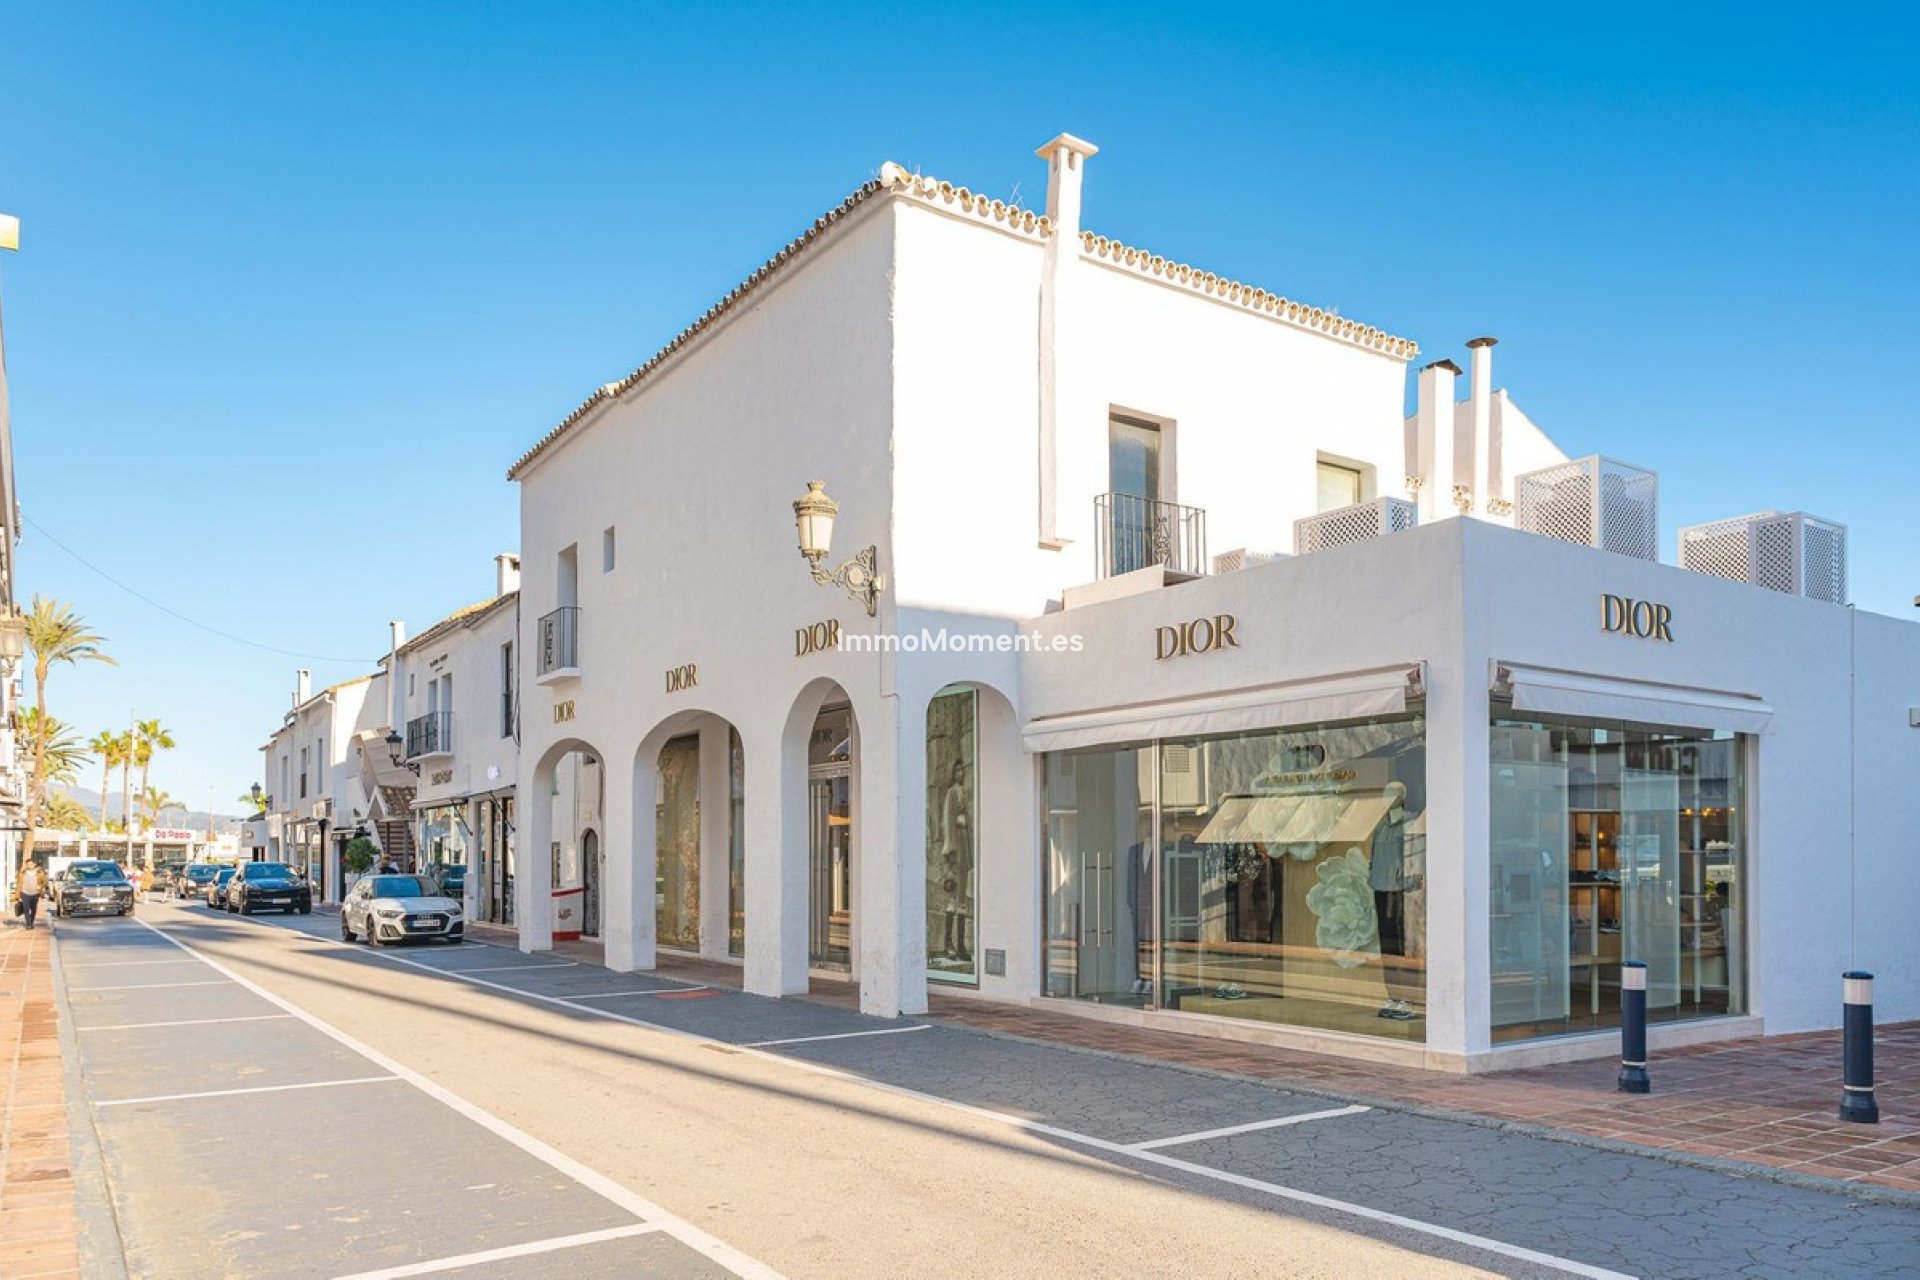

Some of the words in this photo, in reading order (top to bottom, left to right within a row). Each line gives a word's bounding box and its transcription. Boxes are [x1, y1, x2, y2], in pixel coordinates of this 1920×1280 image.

[1601, 593, 1674, 642] DIOR
[796, 619, 839, 657] DIOR
[1154, 614, 1239, 660] DIOR
[665, 664, 697, 692] DIOR
[553, 700, 575, 723] DIOR
